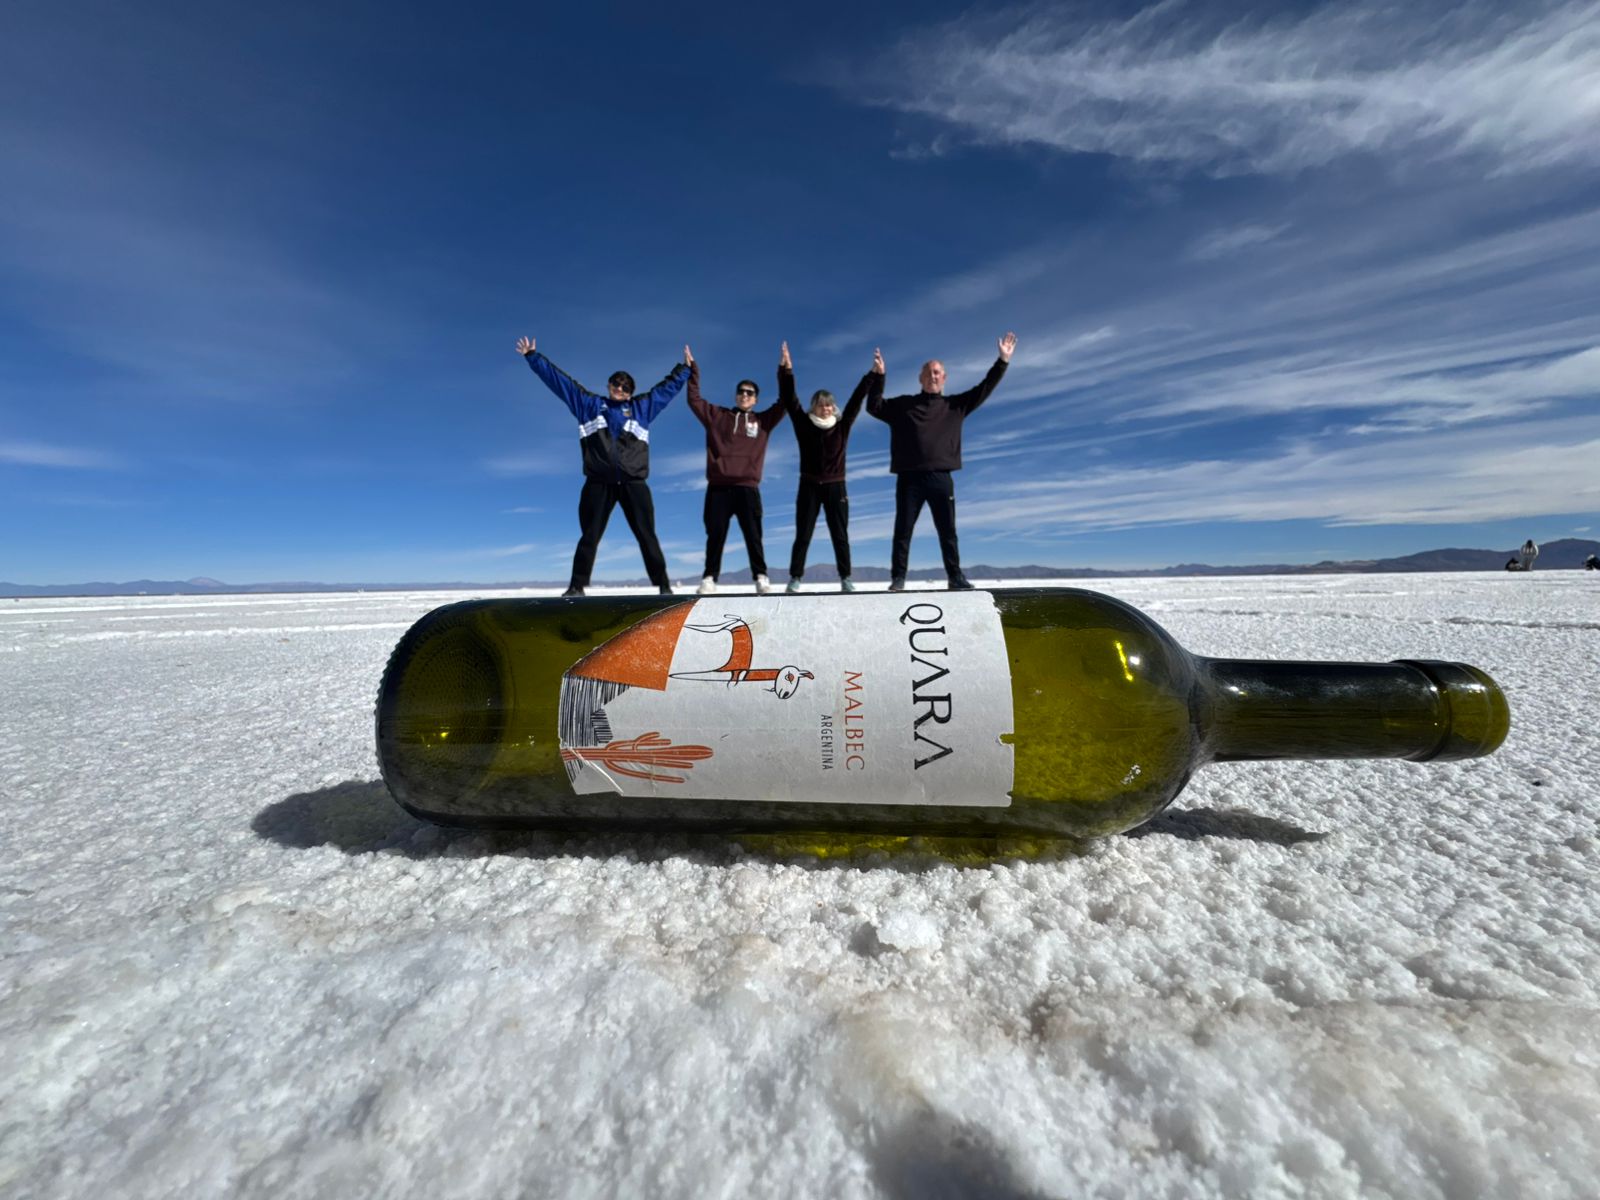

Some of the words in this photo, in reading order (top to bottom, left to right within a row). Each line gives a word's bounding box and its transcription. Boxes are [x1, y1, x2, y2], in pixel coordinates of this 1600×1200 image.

[844, 670, 865, 771] MALBEC
[899, 603, 954, 770] QUARA
[820, 714, 834, 770] ARGENTINA
